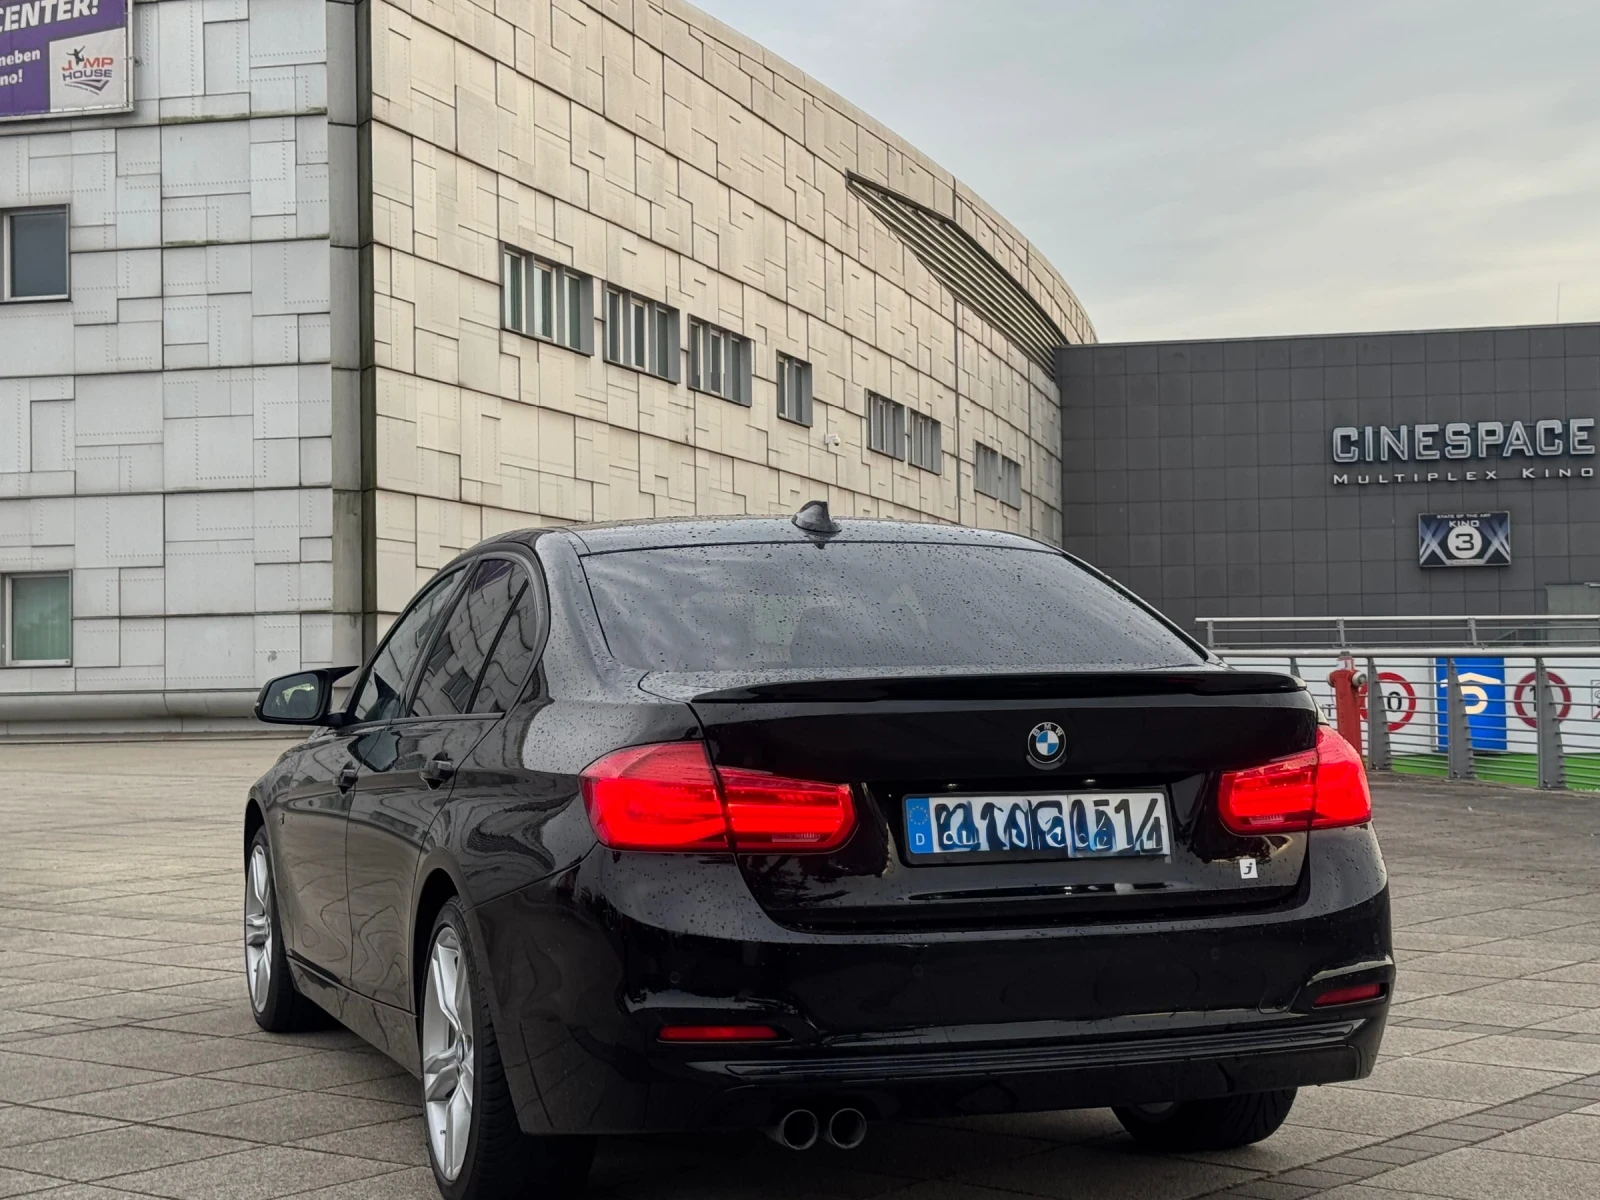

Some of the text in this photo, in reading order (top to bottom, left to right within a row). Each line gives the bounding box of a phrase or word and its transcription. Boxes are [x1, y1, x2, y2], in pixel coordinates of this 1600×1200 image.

[0, 0, 99, 32] ENTER!
[62, 69, 113, 81] HOUSE
[1333, 418, 1596, 463] CINESPACE
[1333, 467, 1595, 485] MULTIPLEX KINO
[1449, 520, 1480, 528] KINO
[1455, 533, 1475, 551] 3
[1032, 723, 1064, 737] BMW
[915, 833, 926, 846] D
